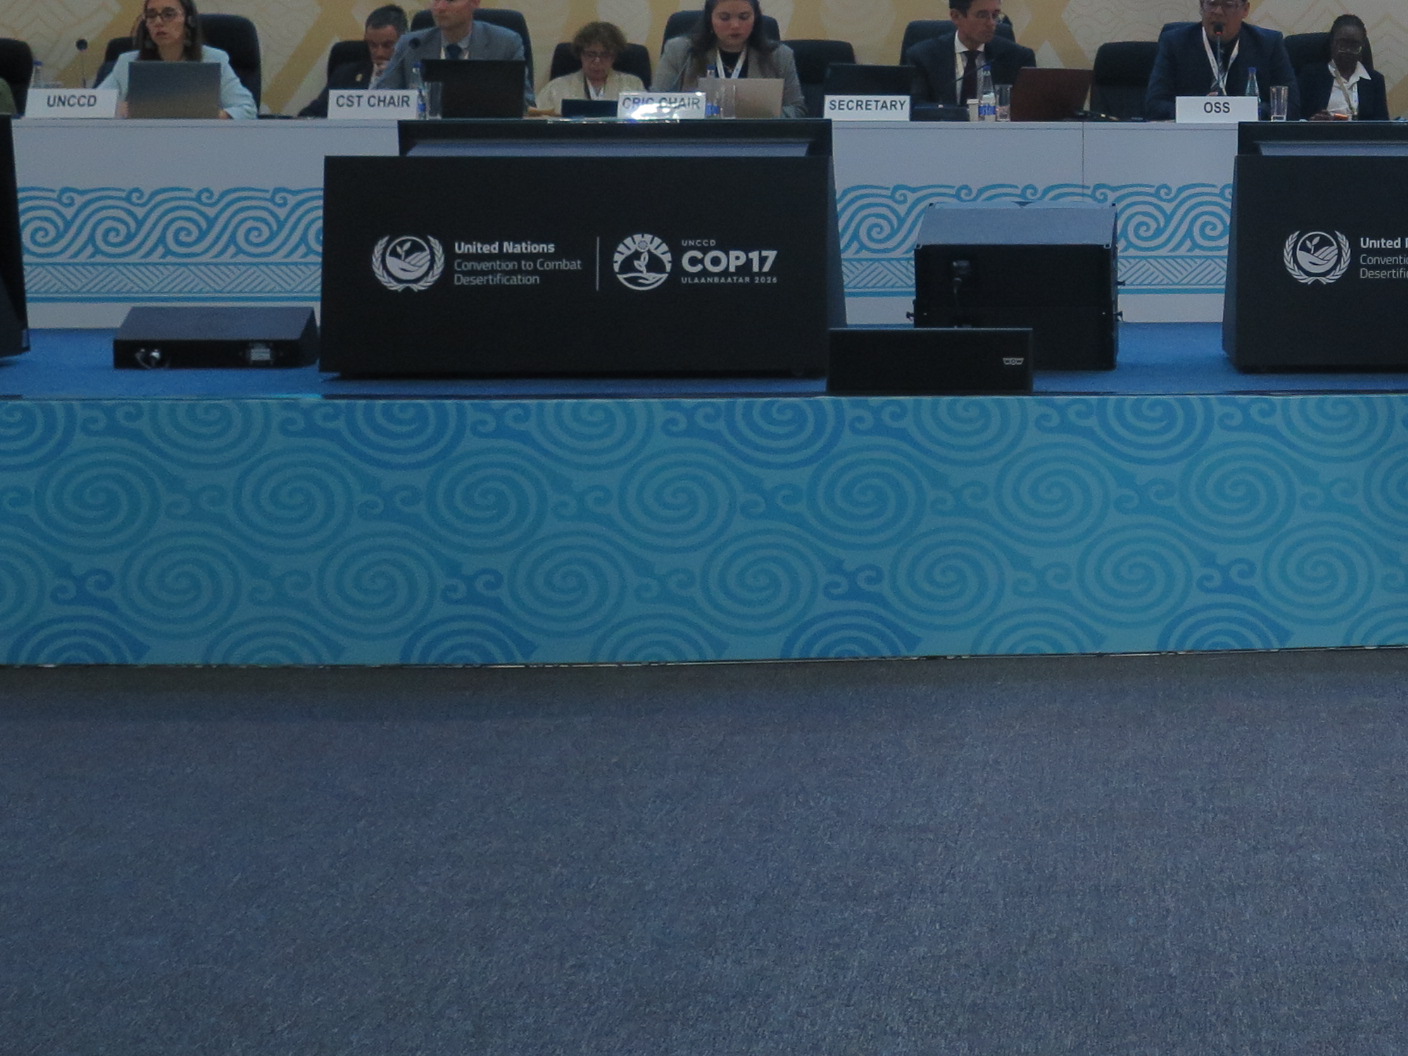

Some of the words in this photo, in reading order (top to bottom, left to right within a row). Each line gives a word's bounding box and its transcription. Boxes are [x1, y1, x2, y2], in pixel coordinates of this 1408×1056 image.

[47, 95, 97, 107] UNCCD
[336, 95, 363, 107] CST
[368, 95, 410, 107] CHAIR
[829, 100, 906, 110] SECRETARY
[1204, 102, 1230, 113] OSS
[455, 241, 499, 253] United
[503, 241, 555, 253] Nations
[1361, 237, 1401, 248] United
[454, 259, 518, 271] Convention
[521, 260, 533, 270] to
[537, 258, 582, 270] Combat
[682, 250, 777, 273] COP17
[454, 273, 539, 285] Desertification
